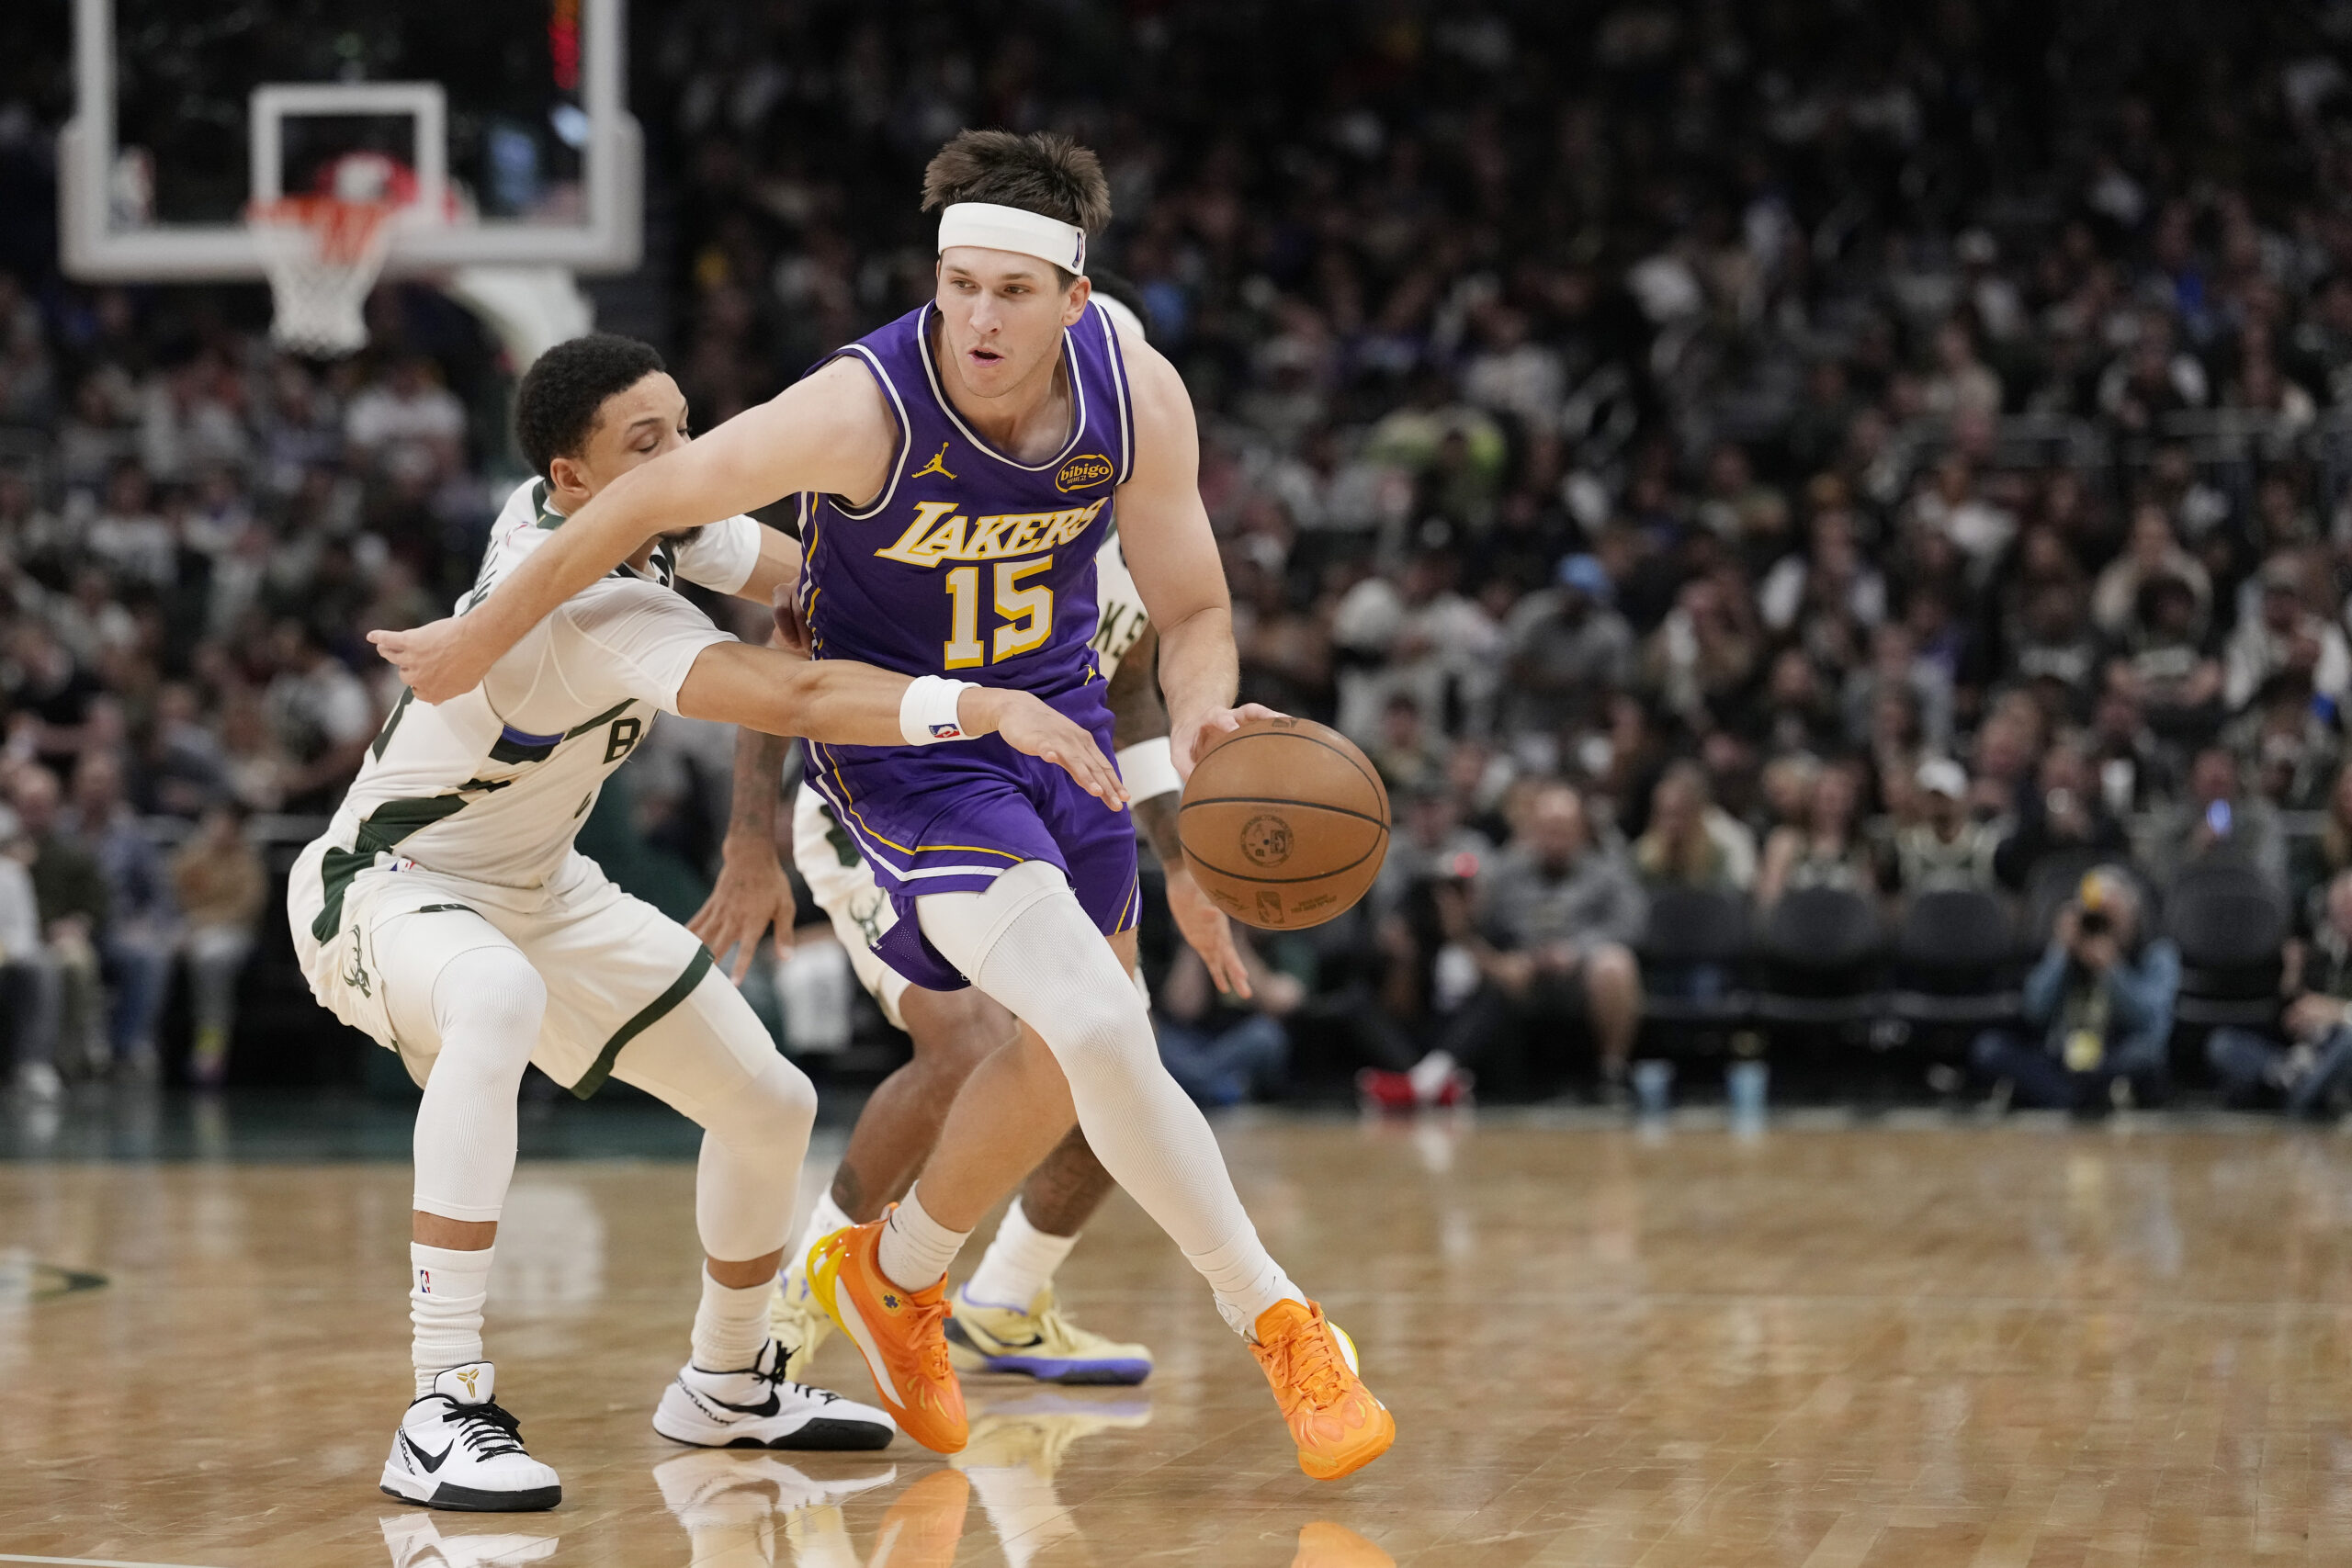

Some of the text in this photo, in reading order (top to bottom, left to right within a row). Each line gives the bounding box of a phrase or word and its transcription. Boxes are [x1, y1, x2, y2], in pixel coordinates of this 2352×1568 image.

[1060, 462, 1110, 481] bibigo
[874, 496, 1110, 569] LAKERS
[944, 554, 1054, 671] 15
